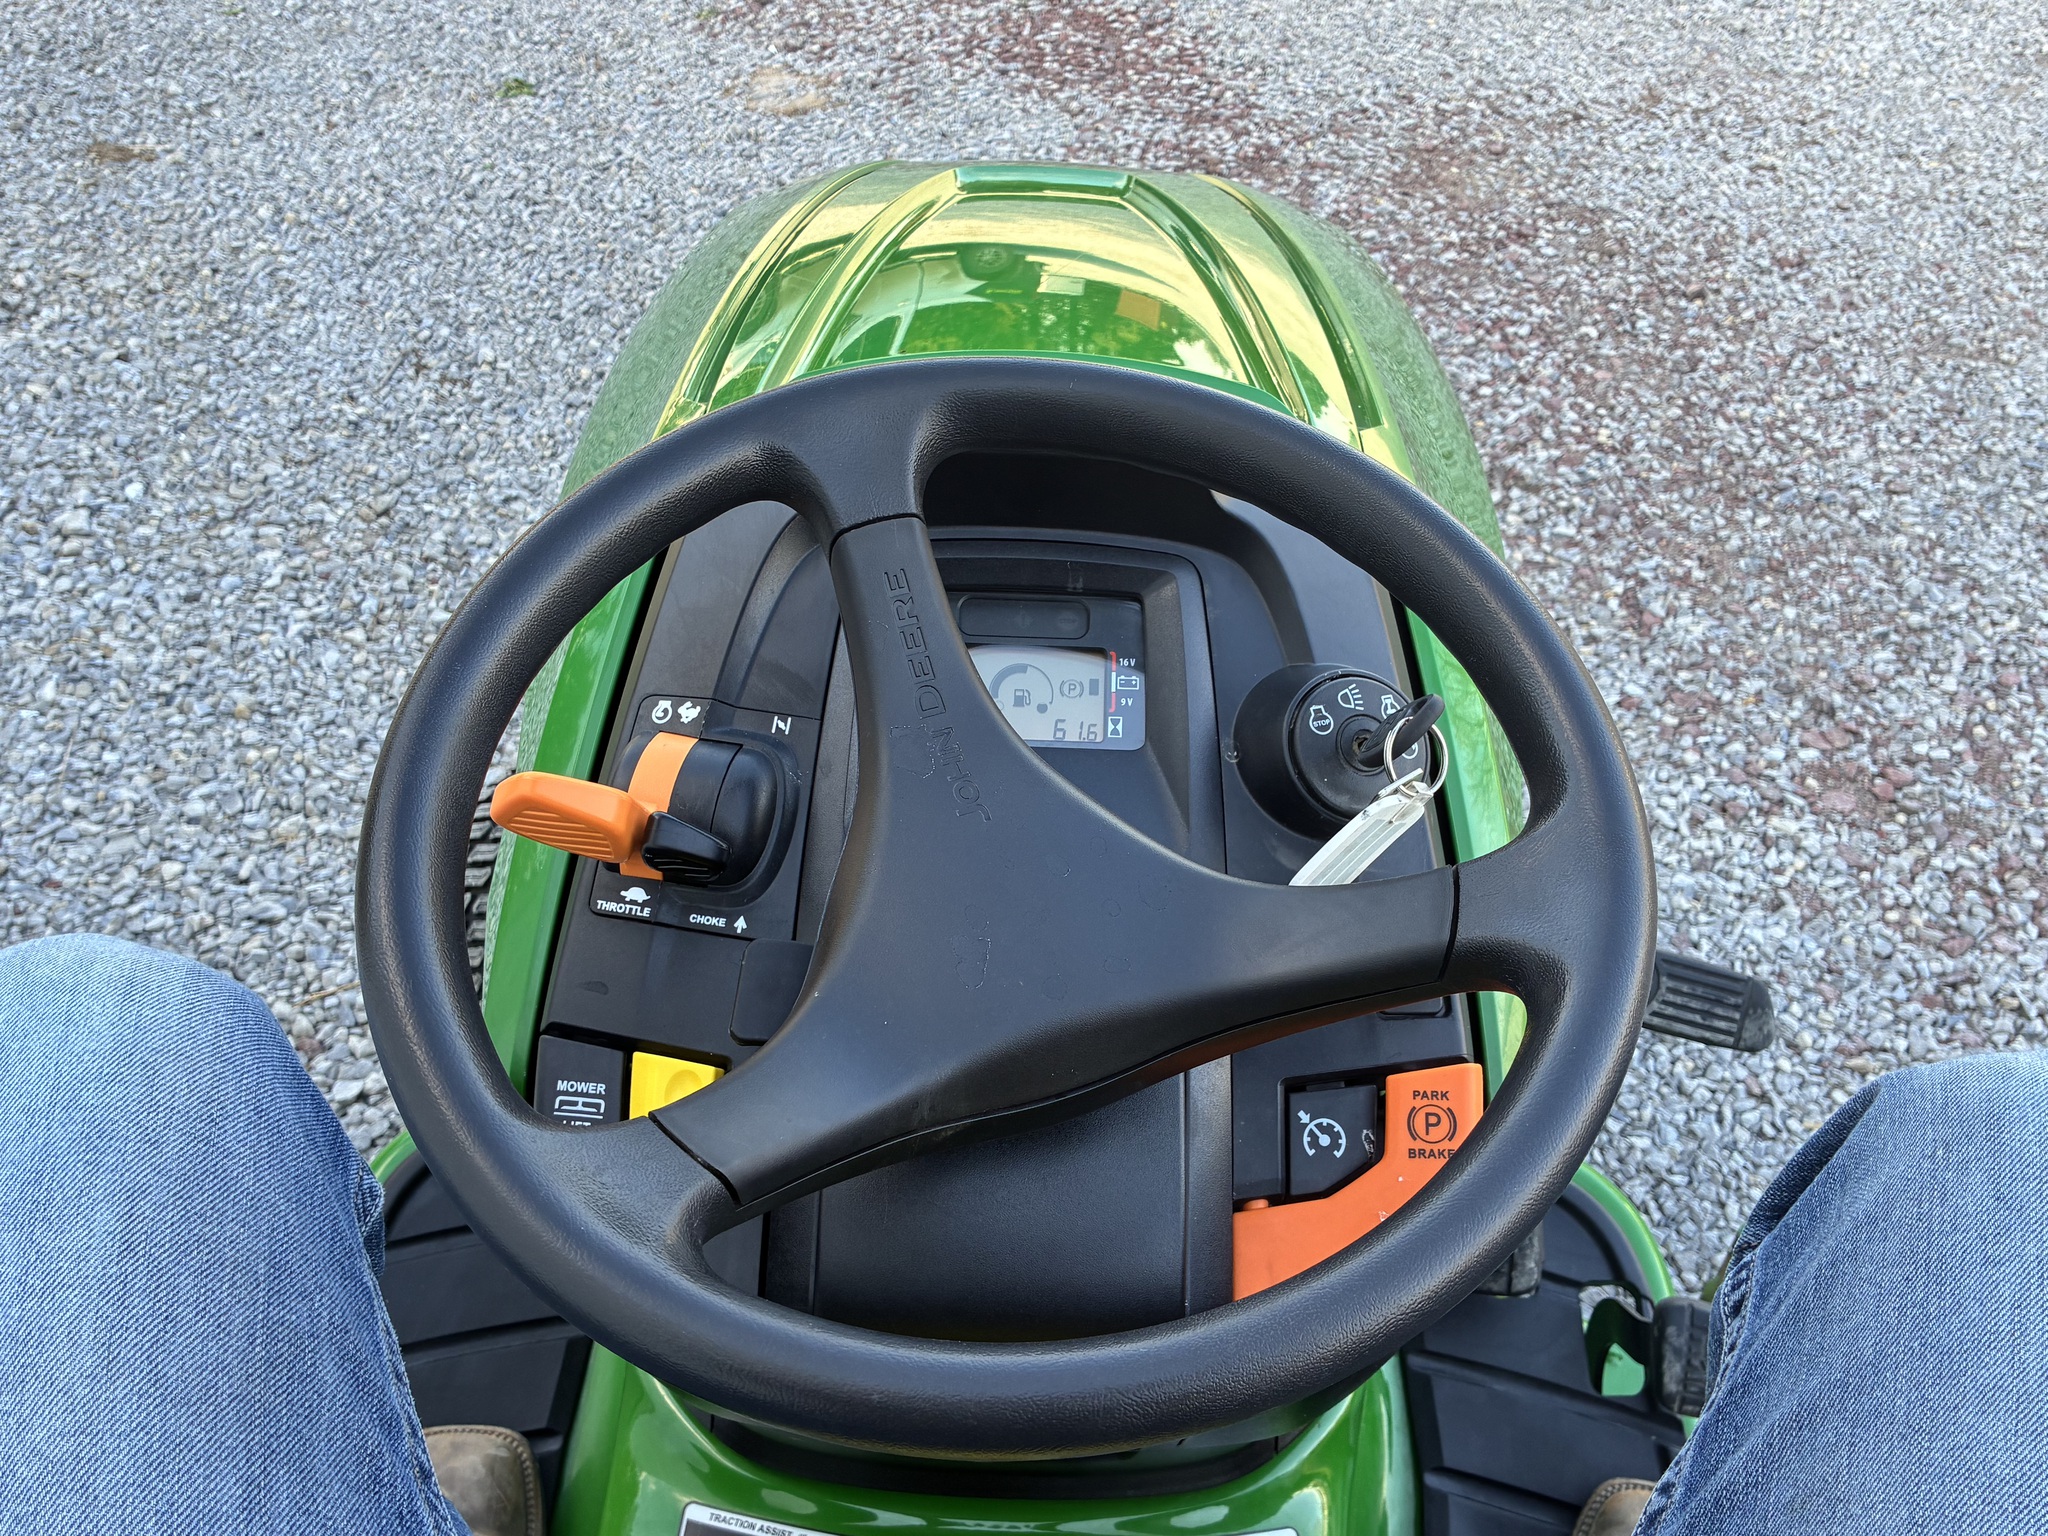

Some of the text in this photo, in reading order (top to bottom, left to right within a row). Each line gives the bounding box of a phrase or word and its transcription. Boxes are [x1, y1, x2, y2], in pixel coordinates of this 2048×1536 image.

[883, 568, 993, 823] JOHN DEERE
[1313, 718, 1331, 727] STOP
[596, 900, 651, 917] THROTTLE
[689, 914, 727, 927] CHOKE
[556, 1079, 606, 1095] MOWER
[1412, 1090, 1450, 1101] PARK
[709, 1512, 757, 1530] TRACTION
